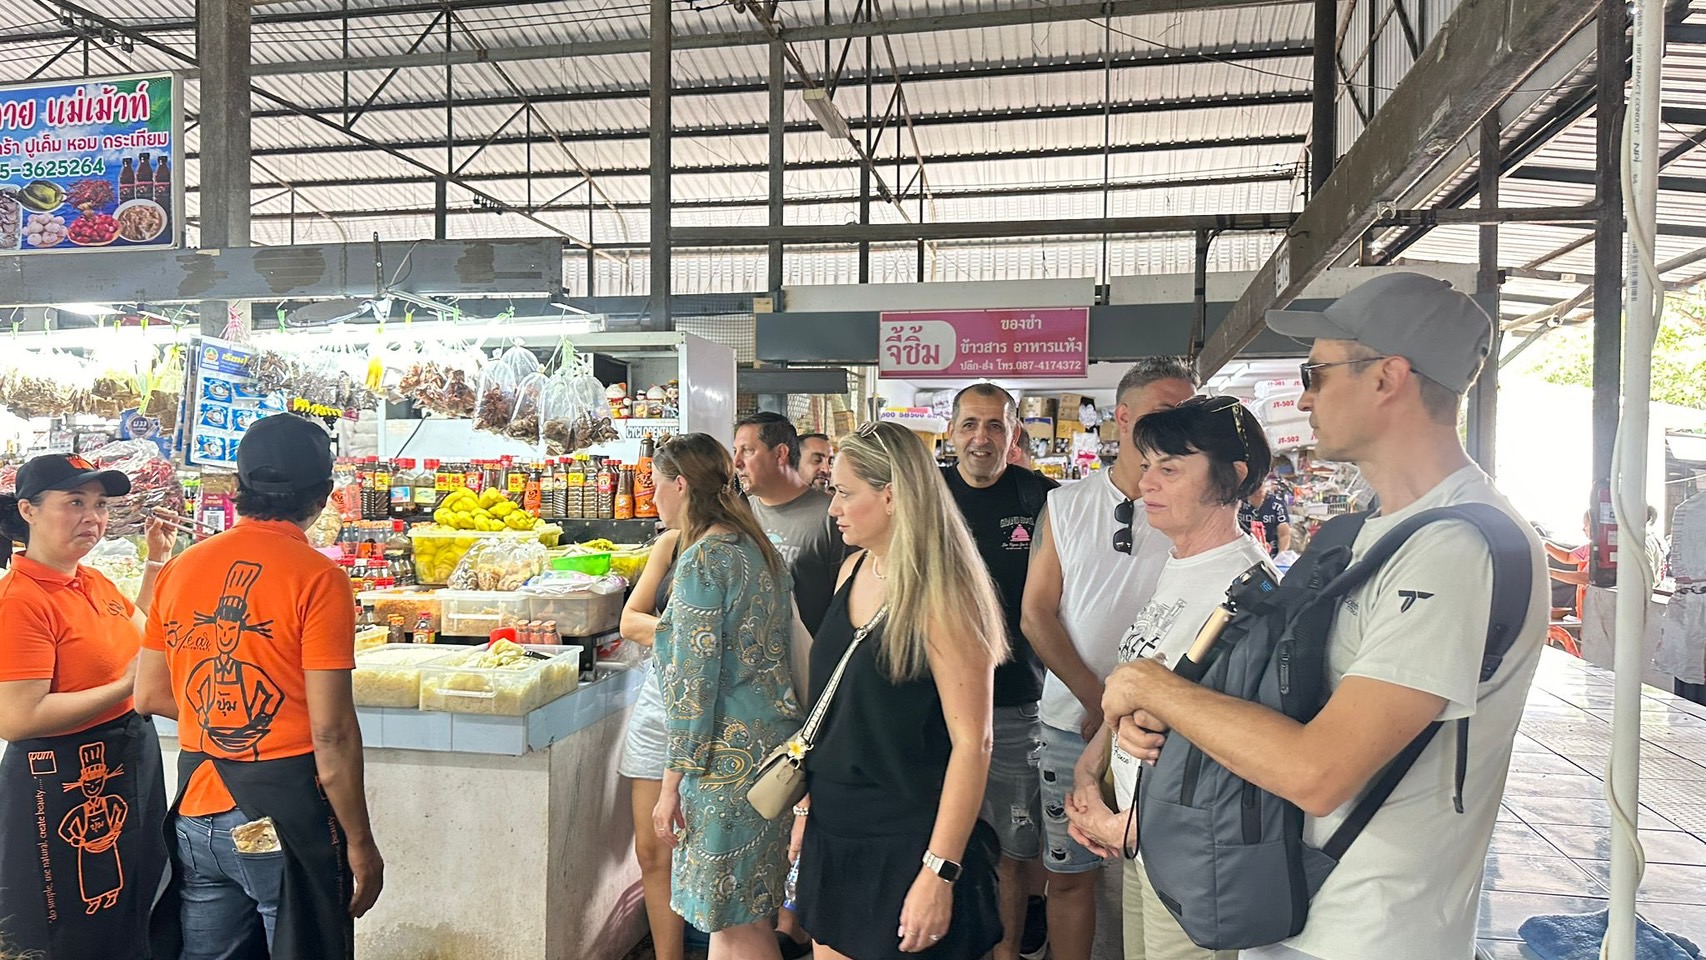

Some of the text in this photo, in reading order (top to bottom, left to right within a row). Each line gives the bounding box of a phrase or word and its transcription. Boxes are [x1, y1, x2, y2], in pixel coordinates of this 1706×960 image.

[0, 101, 34, 127] าย
[25, 134, 62, 158] ปูเค็ม
[67, 138, 97, 150] หอม
[103, 129, 168, 149] กระเทียม
[1000, 313, 1042, 330] ของชำ
[885, 325, 940, 365] จี้ซิ้ม
[960, 336, 1083, 354] ข้าวสาร อาหารแห้ง
[37, 816, 48, 839] create
